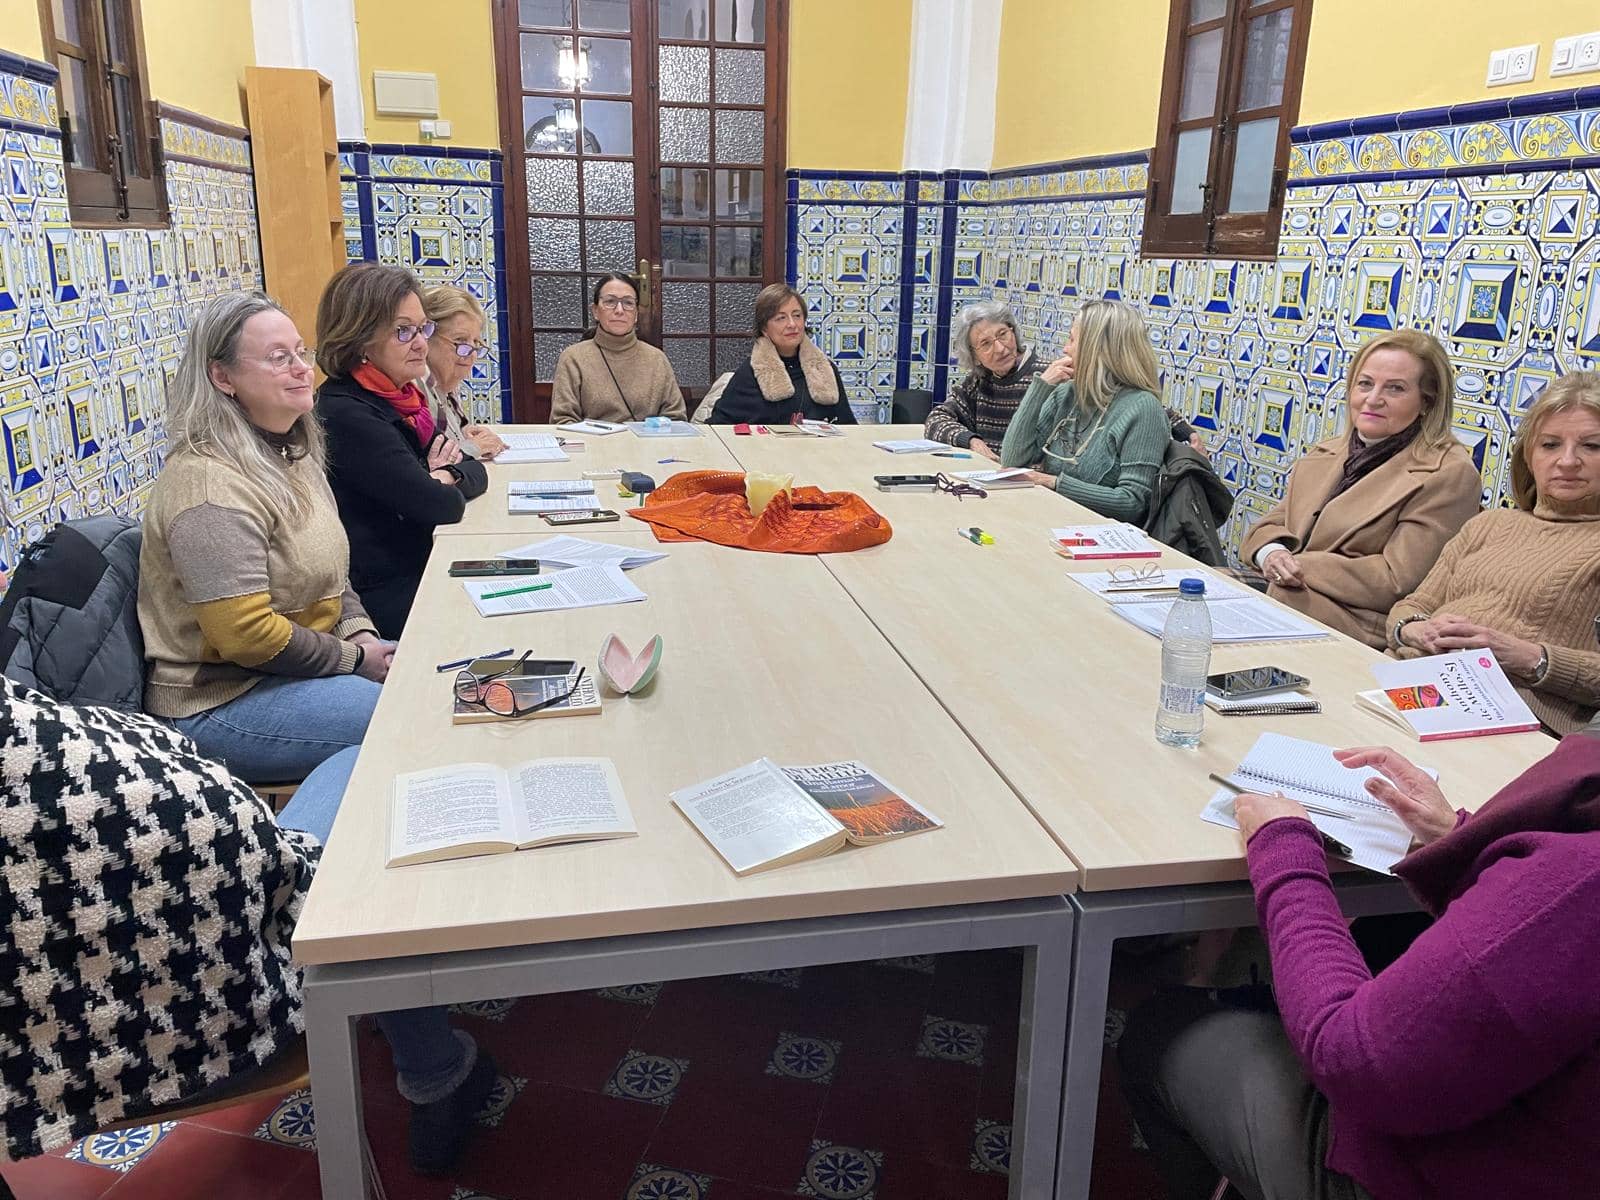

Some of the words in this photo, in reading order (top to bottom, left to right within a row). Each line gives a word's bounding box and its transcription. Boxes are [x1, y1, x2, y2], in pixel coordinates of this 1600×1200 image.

[1445, 662, 1458, 672] SJ
[1440, 672, 1474, 715] Anthony
[1456, 673, 1482, 706] Mello,
[1480, 708, 1493, 721] de
